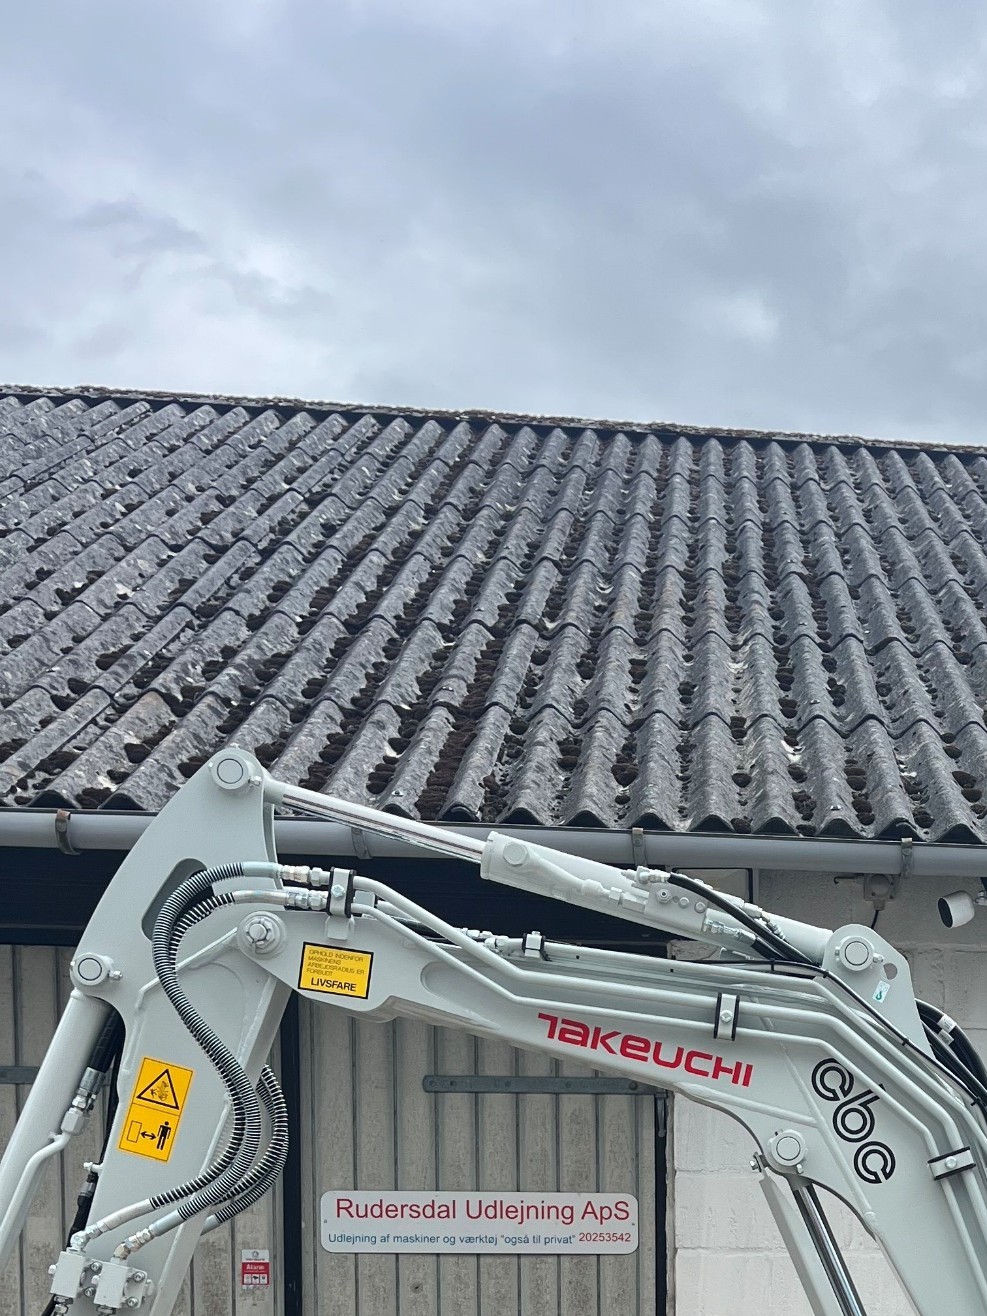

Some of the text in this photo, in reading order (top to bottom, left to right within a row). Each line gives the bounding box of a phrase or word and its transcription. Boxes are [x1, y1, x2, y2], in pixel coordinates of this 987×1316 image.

[308, 956, 341, 965] MASKINENS
[309, 949, 363, 962] OPHOLD INDENFOR
[306, 968, 333, 976] FORBUDT
[307, 962, 355, 974] ARBEJDSRADIUS
[311, 977, 357, 992] LIVSFARE
[811, 1057, 896, 1184] cbc
[336, 1198, 629, 1225] Rudersdal Udlejning ApS
[328, 1234, 377, 1245] Udlejning
[380, 1234, 390, 1243] af
[393, 1234, 440, 1243] maskiner
[443, 1236, 456, 1245] og
[459, 1234, 497, 1245] værktøj
[532, 1234, 541, 1244] til
[579, 1232, 631, 1242] 20253542
